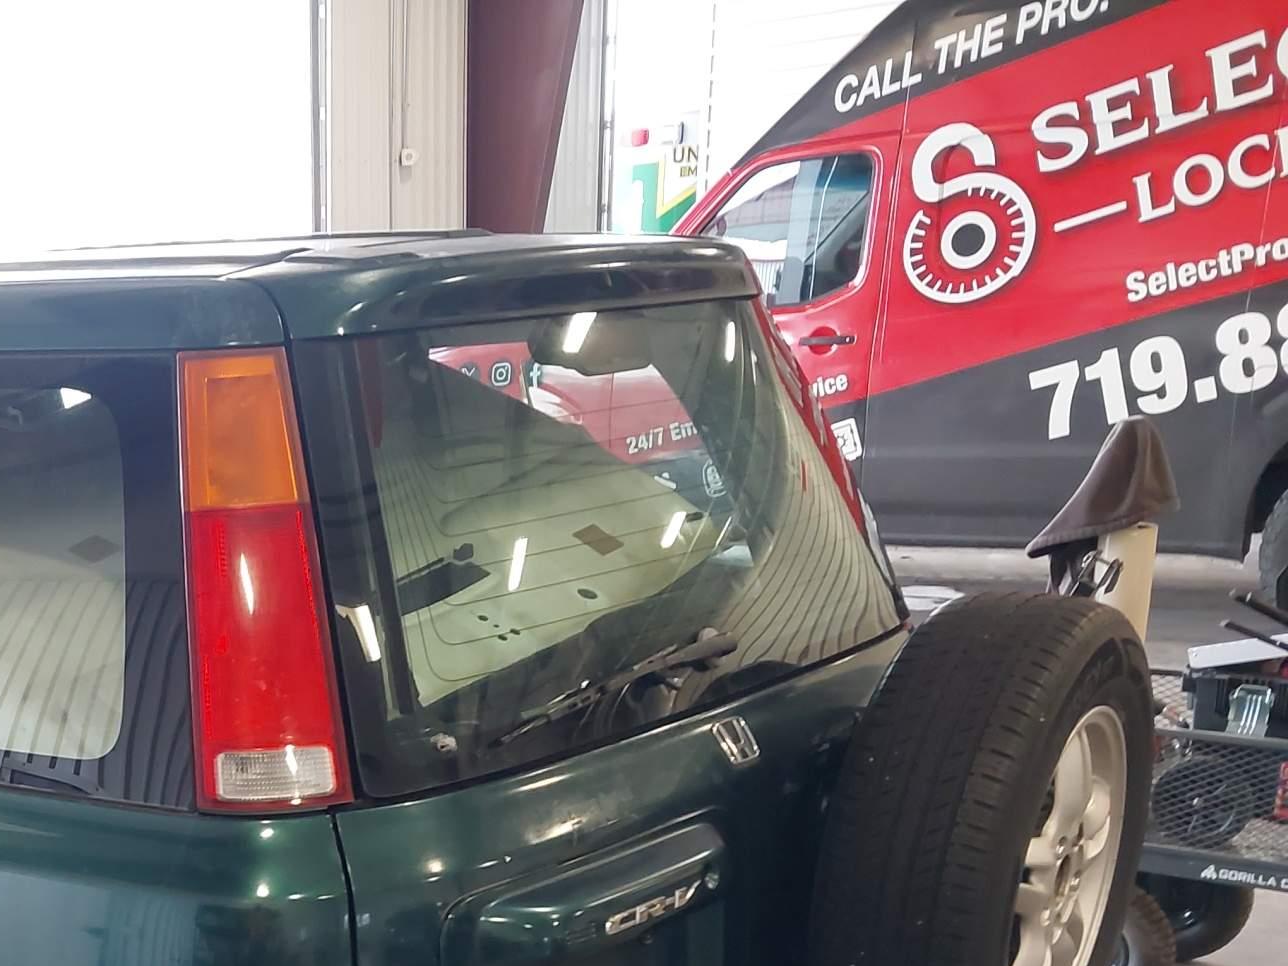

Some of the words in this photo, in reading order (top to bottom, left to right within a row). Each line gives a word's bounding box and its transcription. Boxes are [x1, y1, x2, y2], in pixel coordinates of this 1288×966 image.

[834, 50, 922, 113] CALL
[934, 13, 1007, 75] THE
[1031, 26, 1288, 173] SELE
[1125, 237, 1288, 303] SelectPro
[1028, 302, 1288, 441] 719.8
[626, 427, 664, 455] 24/7
[605, 880, 702, 935] CR-V
[1218, 868, 1277, 887] GORILLA
